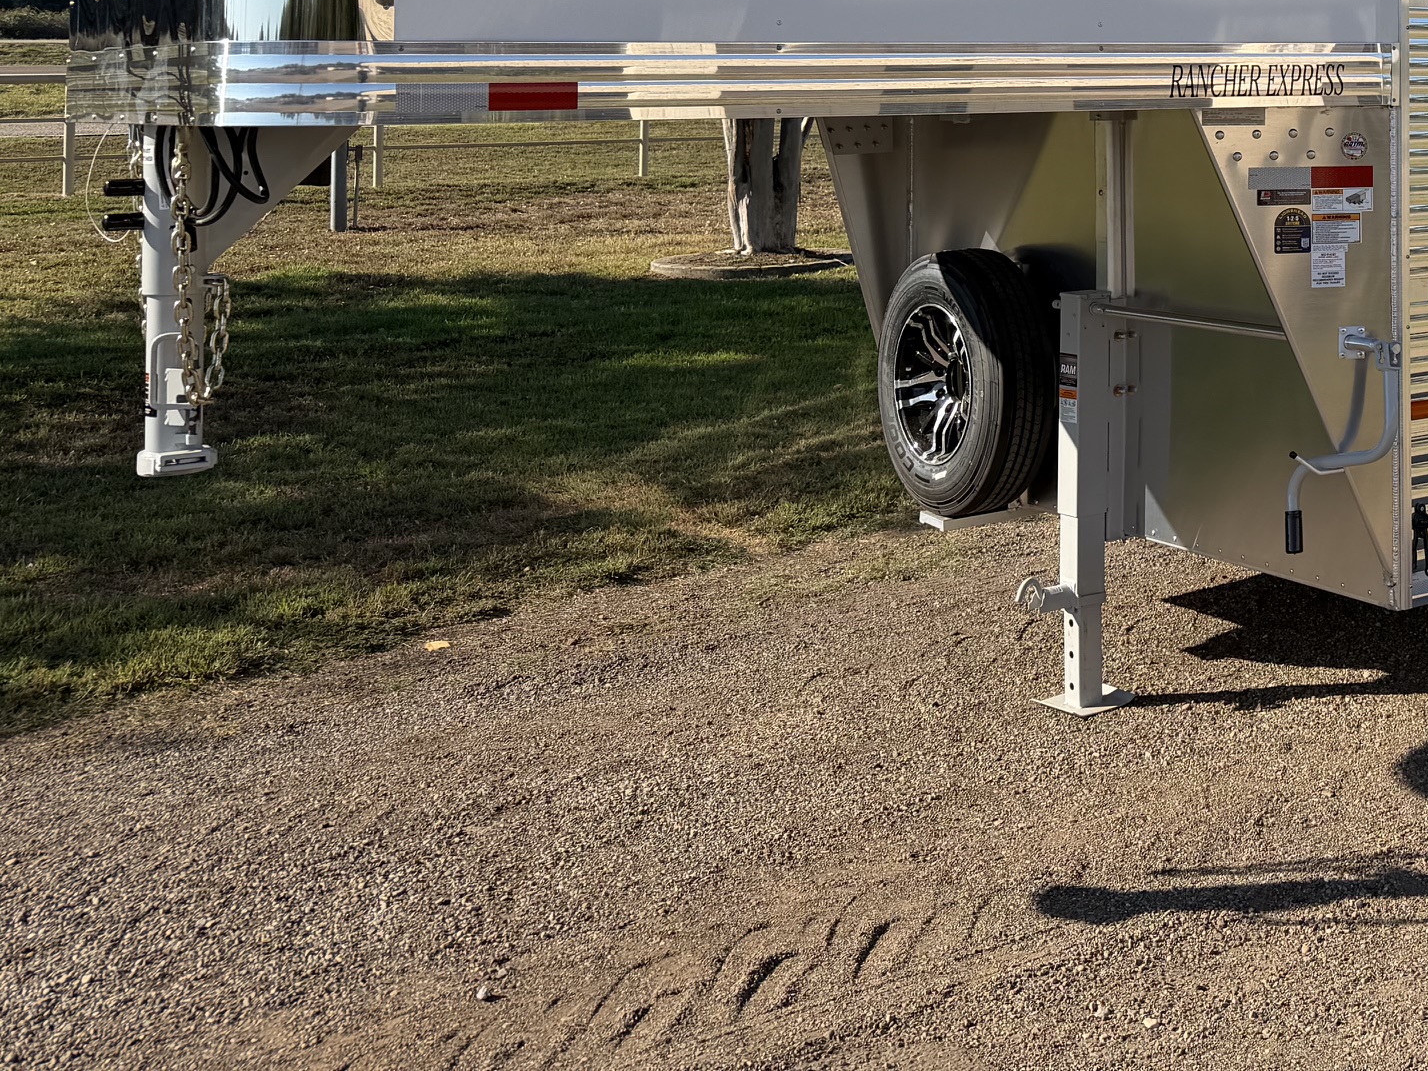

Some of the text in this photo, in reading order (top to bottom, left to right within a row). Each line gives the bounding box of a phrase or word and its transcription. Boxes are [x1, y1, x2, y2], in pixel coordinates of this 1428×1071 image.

[1169, 63, 1345, 98] RANCHER EXPRESS
[1060, 363, 1077, 375] RAM
